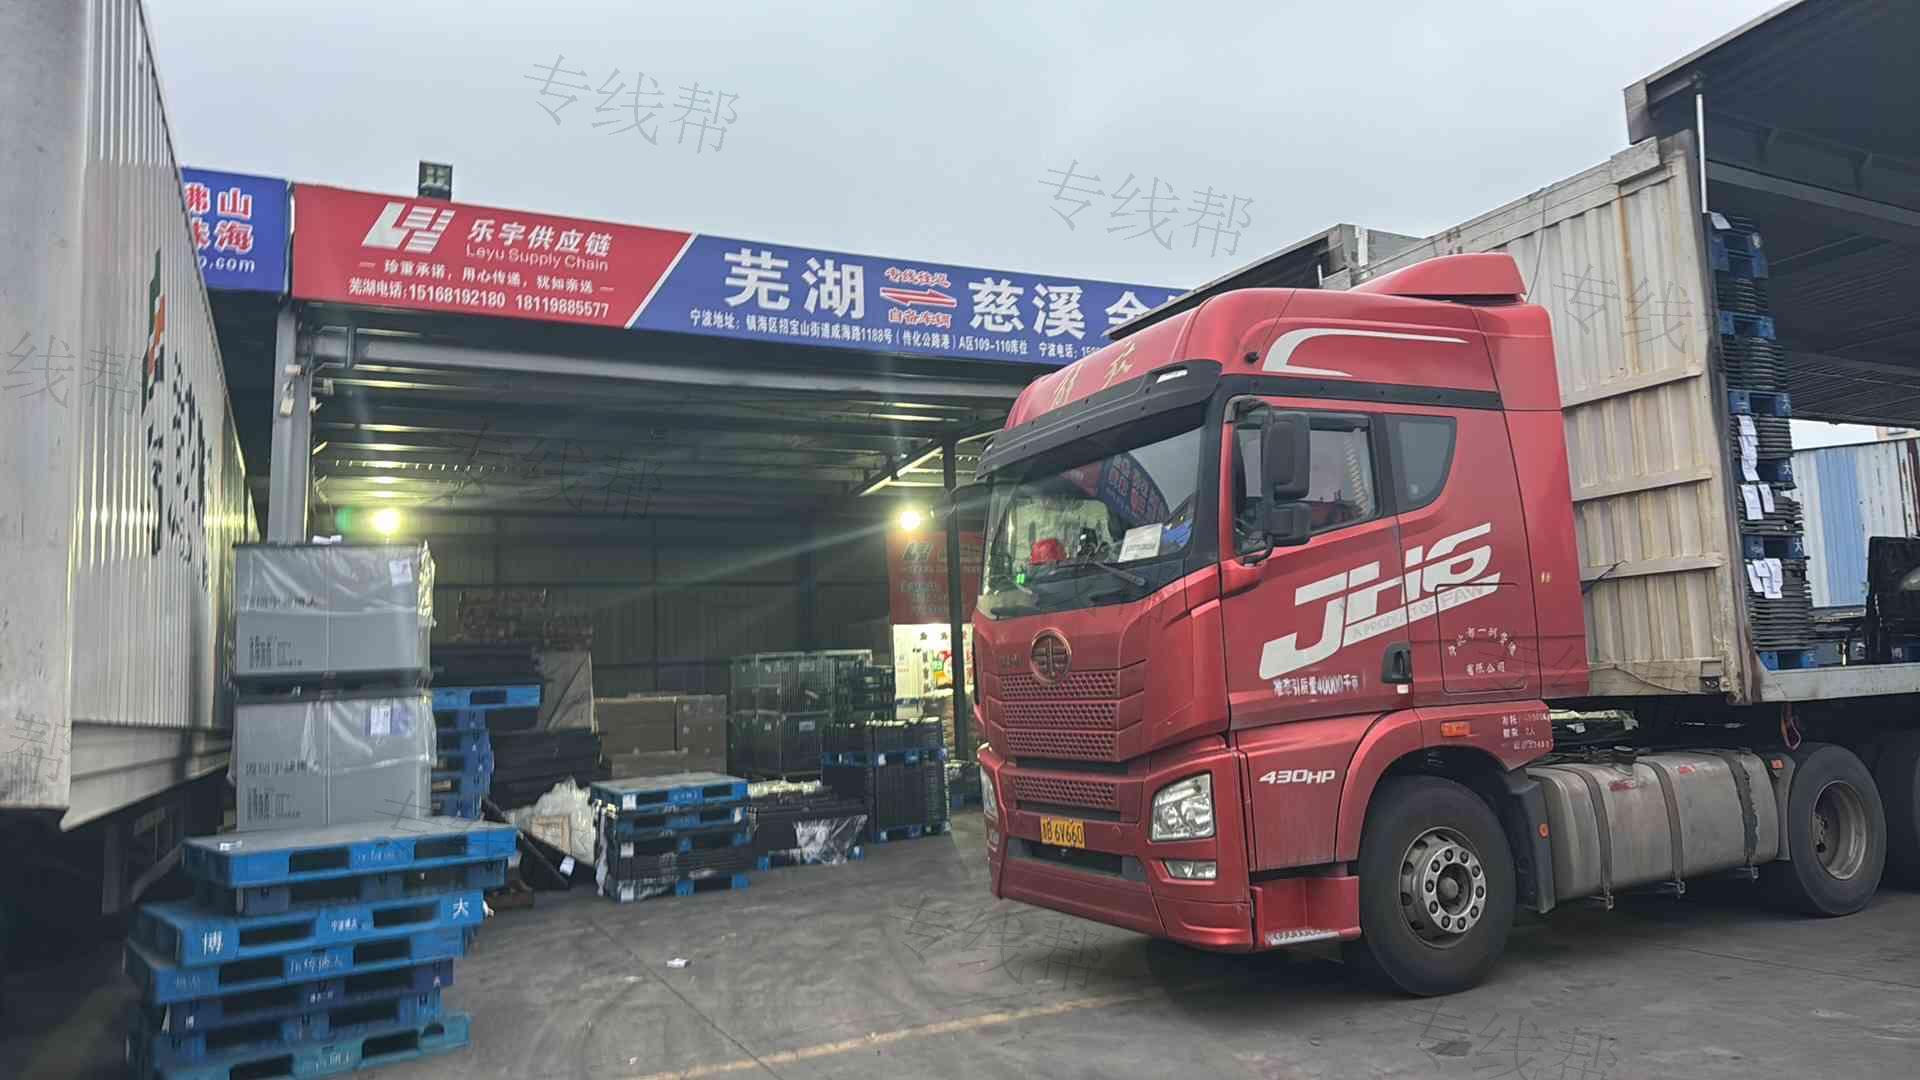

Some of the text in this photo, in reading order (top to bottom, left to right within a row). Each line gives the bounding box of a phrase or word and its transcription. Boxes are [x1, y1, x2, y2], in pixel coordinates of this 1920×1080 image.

[467, 218, 613, 257] 乐宇供应链
[466, 244, 609, 273] Leyu Supply Chain
[724, 247, 865, 319] 芜湖
[968, 277, 1086, 339] 慈溪
[1259, 769, 1336, 784] 430HP
[453, 897, 469, 919] 大
